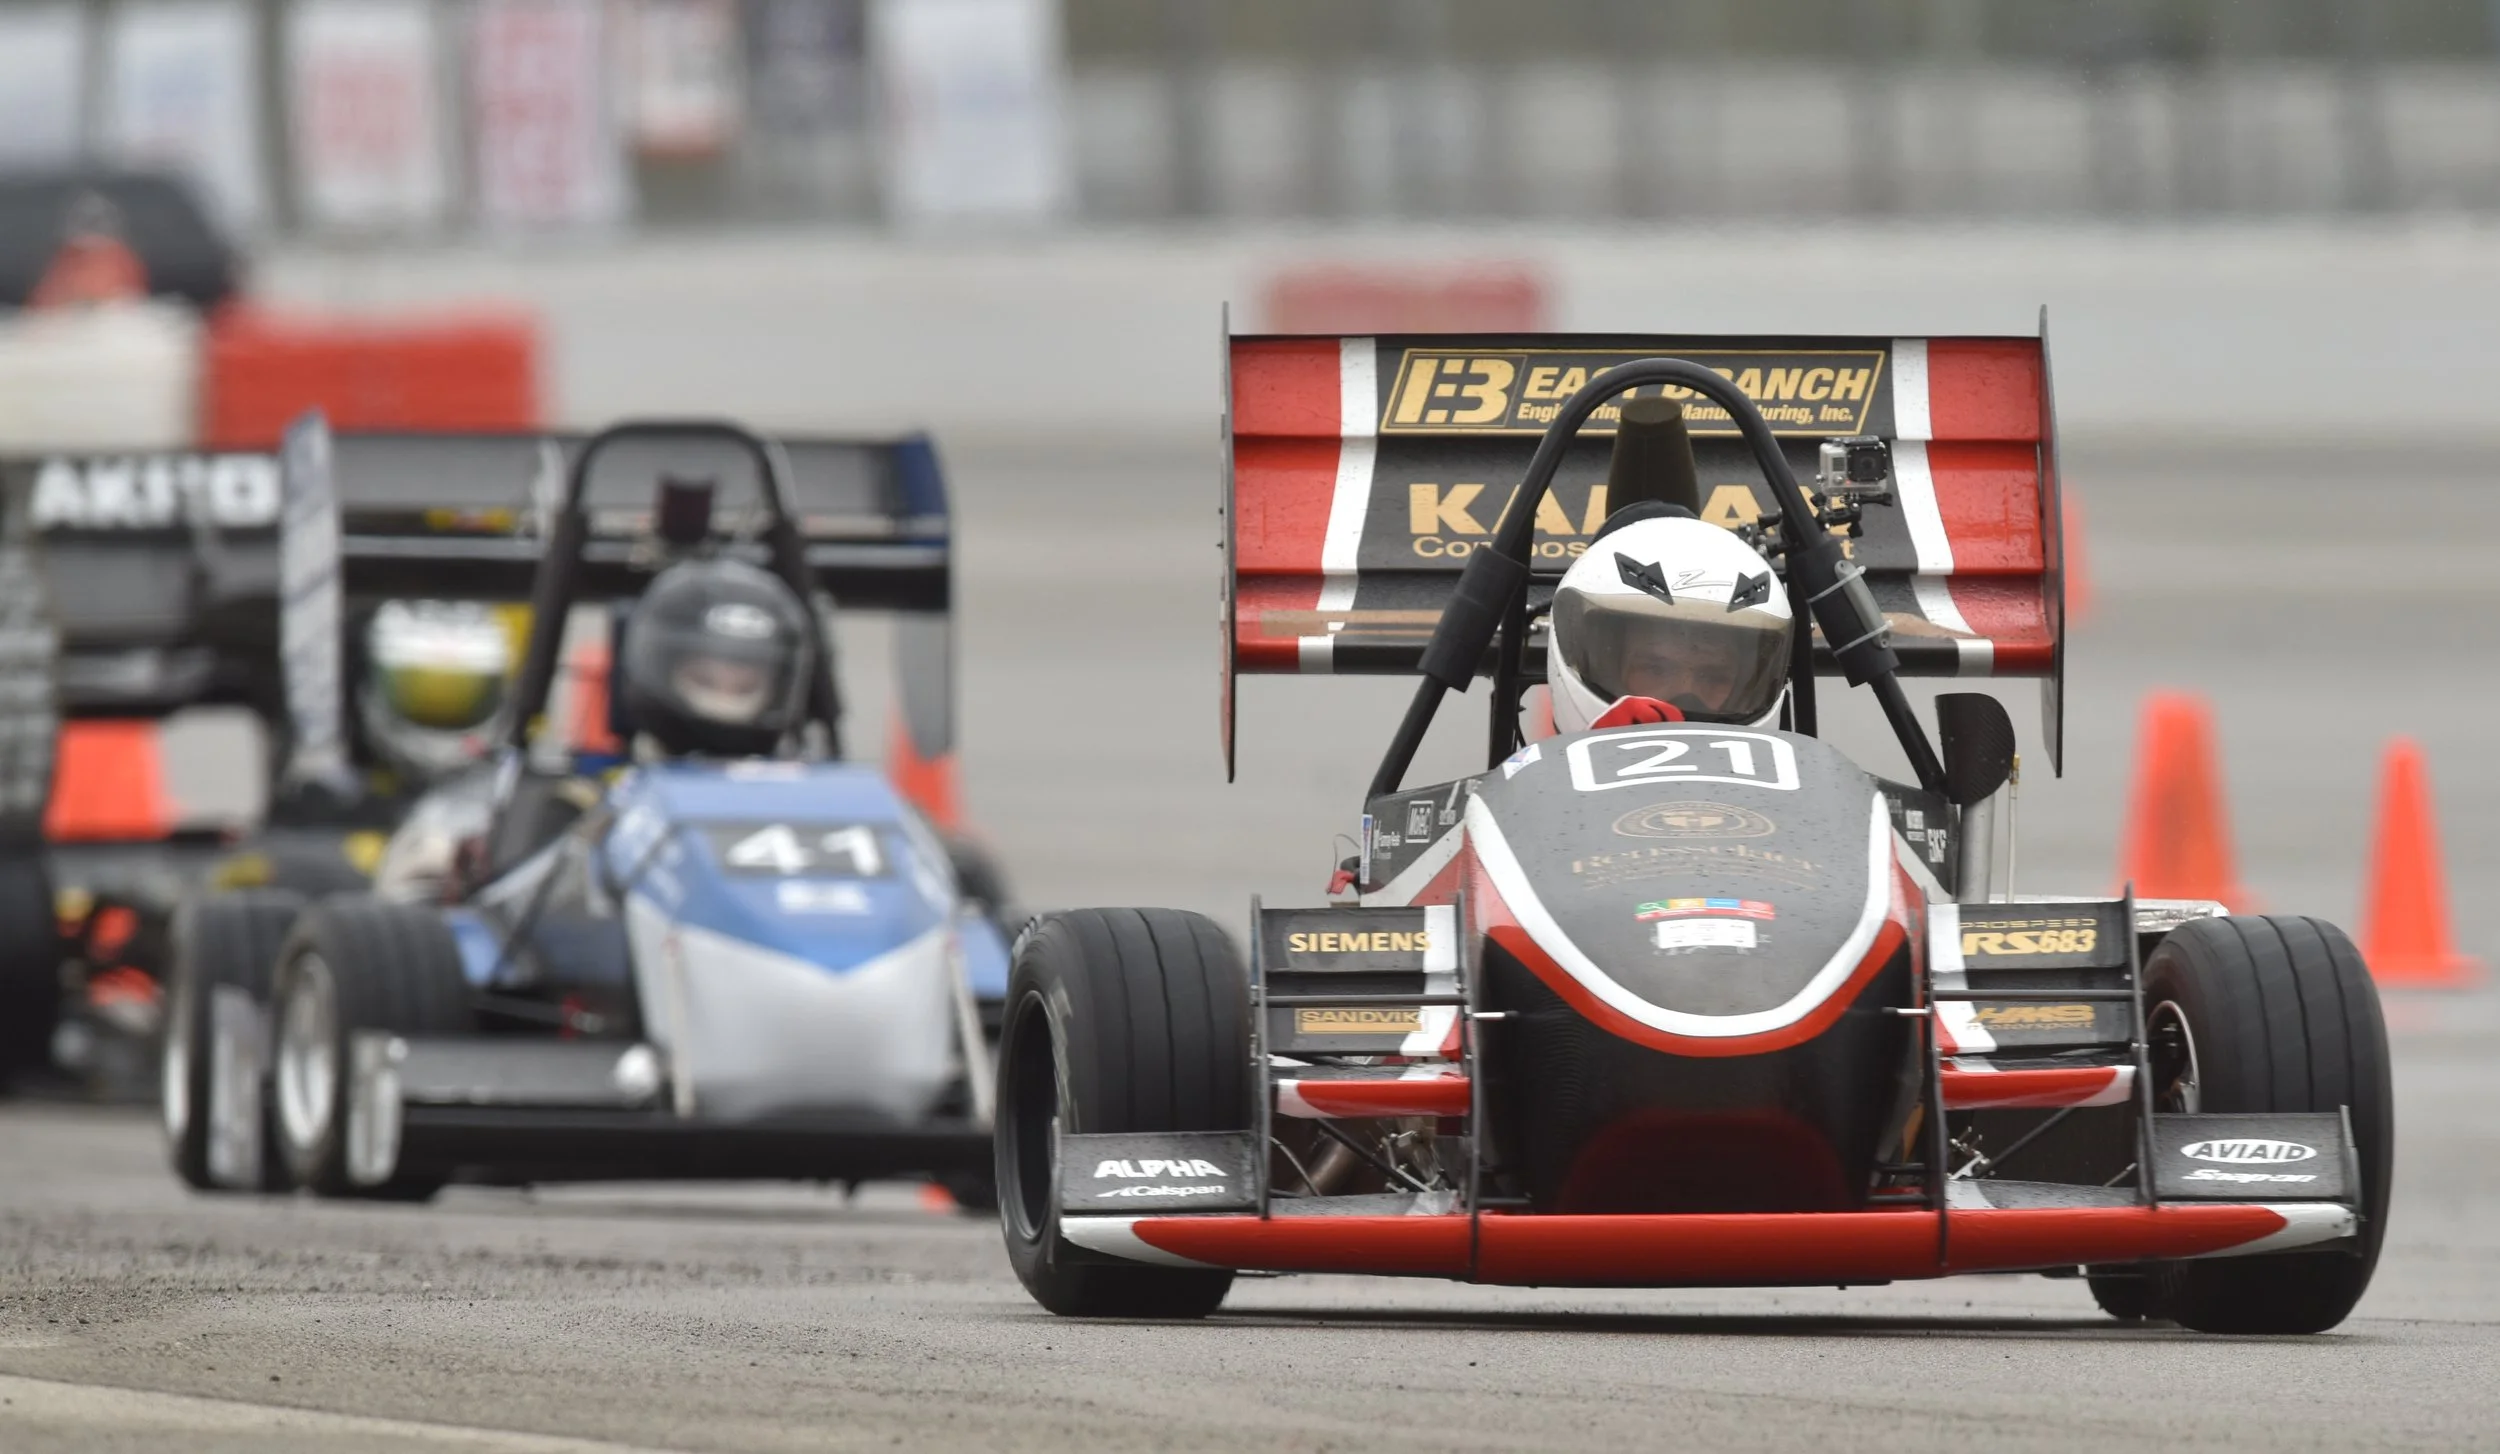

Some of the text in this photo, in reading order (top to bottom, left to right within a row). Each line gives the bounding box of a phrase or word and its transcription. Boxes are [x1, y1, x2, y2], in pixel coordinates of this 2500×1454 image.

[1523, 367, 1638, 399] EA
[1819, 404, 1854, 422] Inc.
[1409, 484, 1855, 536] KAA
[1616, 740, 1755, 776] 21
[727, 825, 882, 875] 41
[1288, 932, 1431, 952] SIEMENS
[1962, 929, 2098, 956] RS683
[1302, 1011, 1420, 1023] SANDVIK
[2192, 1142, 2308, 1160] AVIAID
[1094, 1159, 1229, 1178] ALPHA
[1130, 1185, 1226, 1197] Calspan
